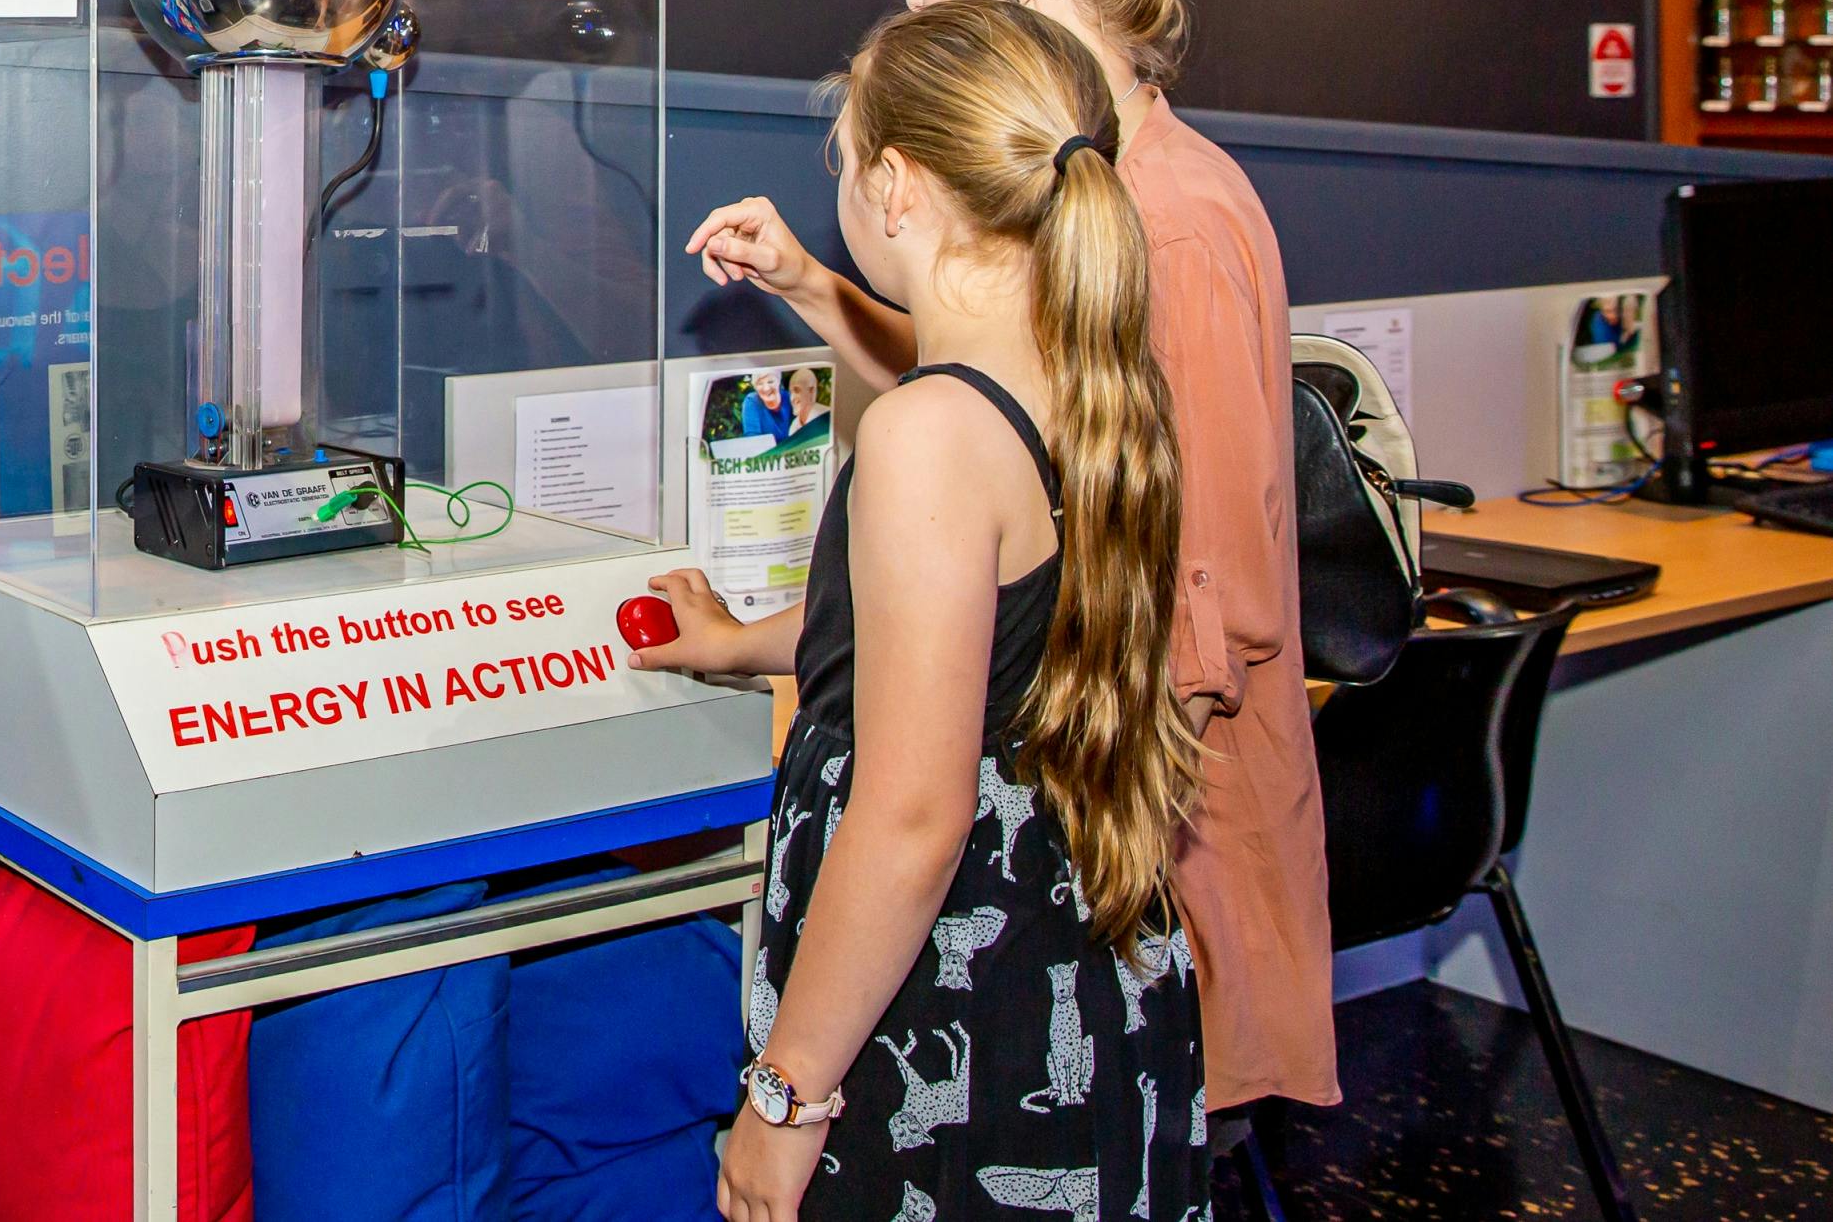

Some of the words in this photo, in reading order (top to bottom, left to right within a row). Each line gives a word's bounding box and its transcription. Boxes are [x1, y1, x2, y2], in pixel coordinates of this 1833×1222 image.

[710, 457, 741, 476] TECH
[744, 457, 782, 474] SAVVY
[784, 449, 820, 470] SENIORS
[261, 491, 279, 499] VAN
[282, 489, 293, 497] DE
[296, 485, 327, 495] GRAAFF
[263, 498, 300, 506] ELECTROSTATIC
[301, 494, 329, 502] GENERATOR
[161, 629, 262, 668] Push
[271, 623, 331, 654] the
[338, 608, 455, 645] button
[461, 600, 497, 627] to
[506, 594, 565, 621] see
[169, 681, 368, 747] ENERGY
[383, 673, 432, 714] IN
